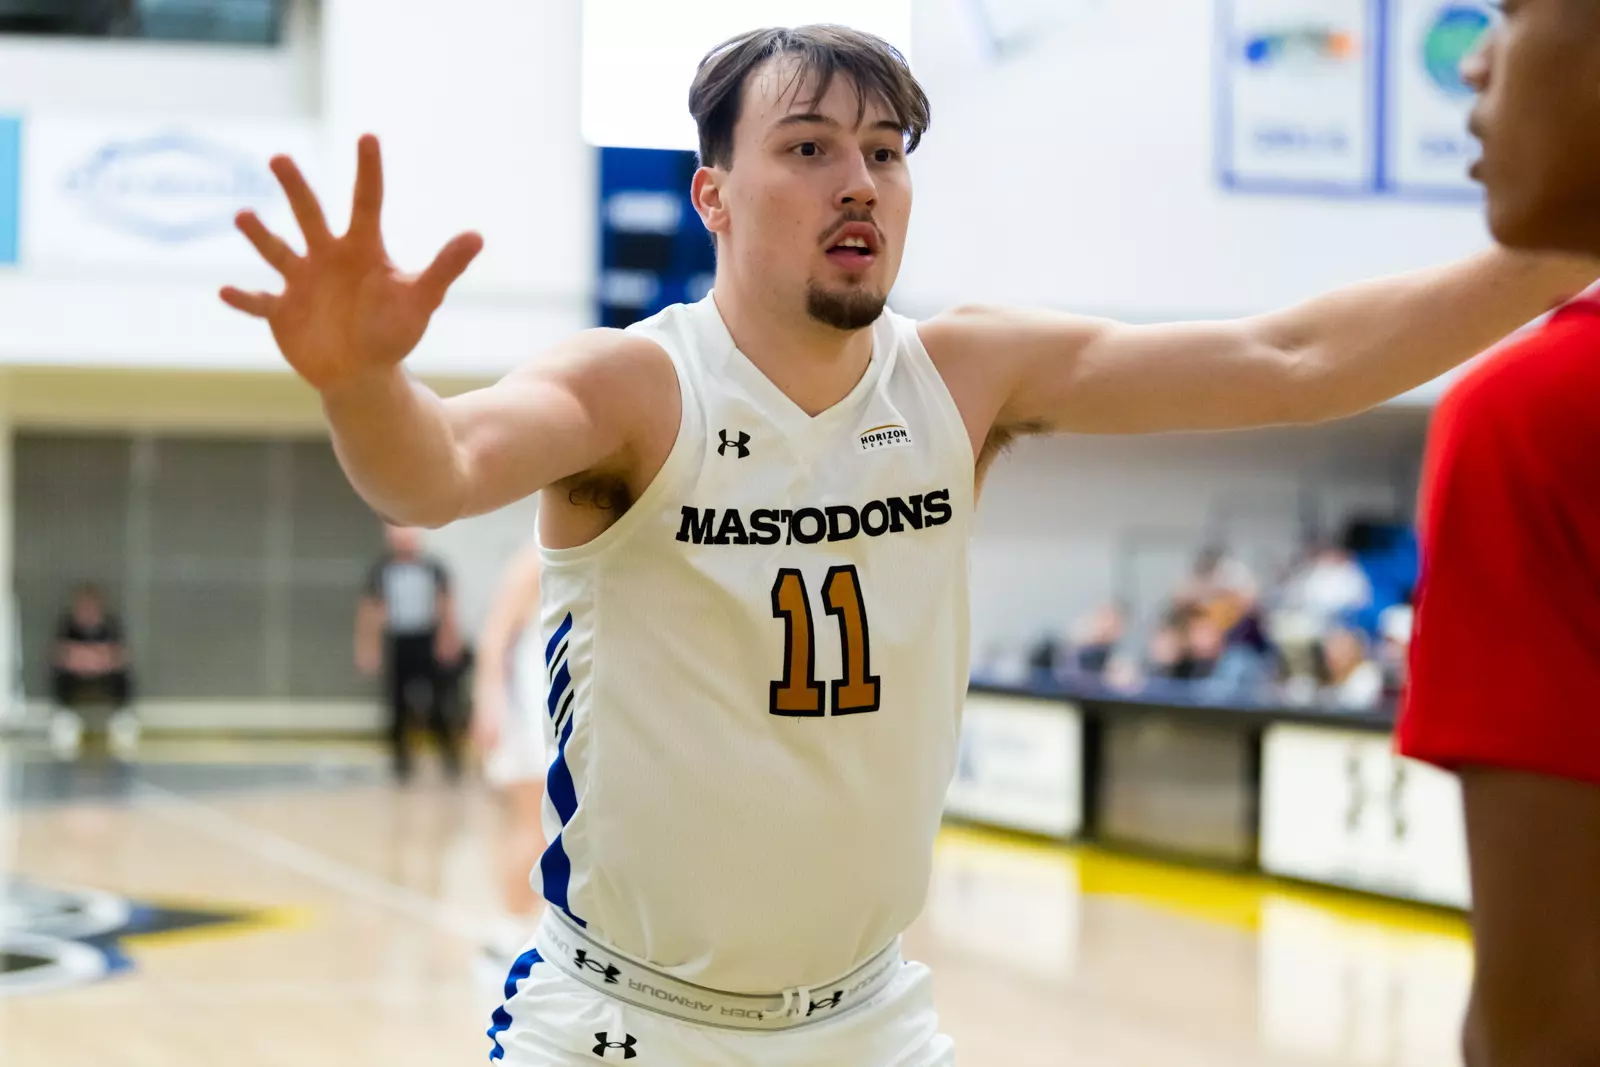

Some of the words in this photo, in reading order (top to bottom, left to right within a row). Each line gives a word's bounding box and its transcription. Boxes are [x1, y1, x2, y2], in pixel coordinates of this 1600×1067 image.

[861, 429, 907, 444] HORIZON
[862, 438, 909, 450] LEAGUE
[675, 488, 953, 546] MASTODONS
[769, 564, 881, 717] 11
[627, 978, 714, 1012] ARMOUR
